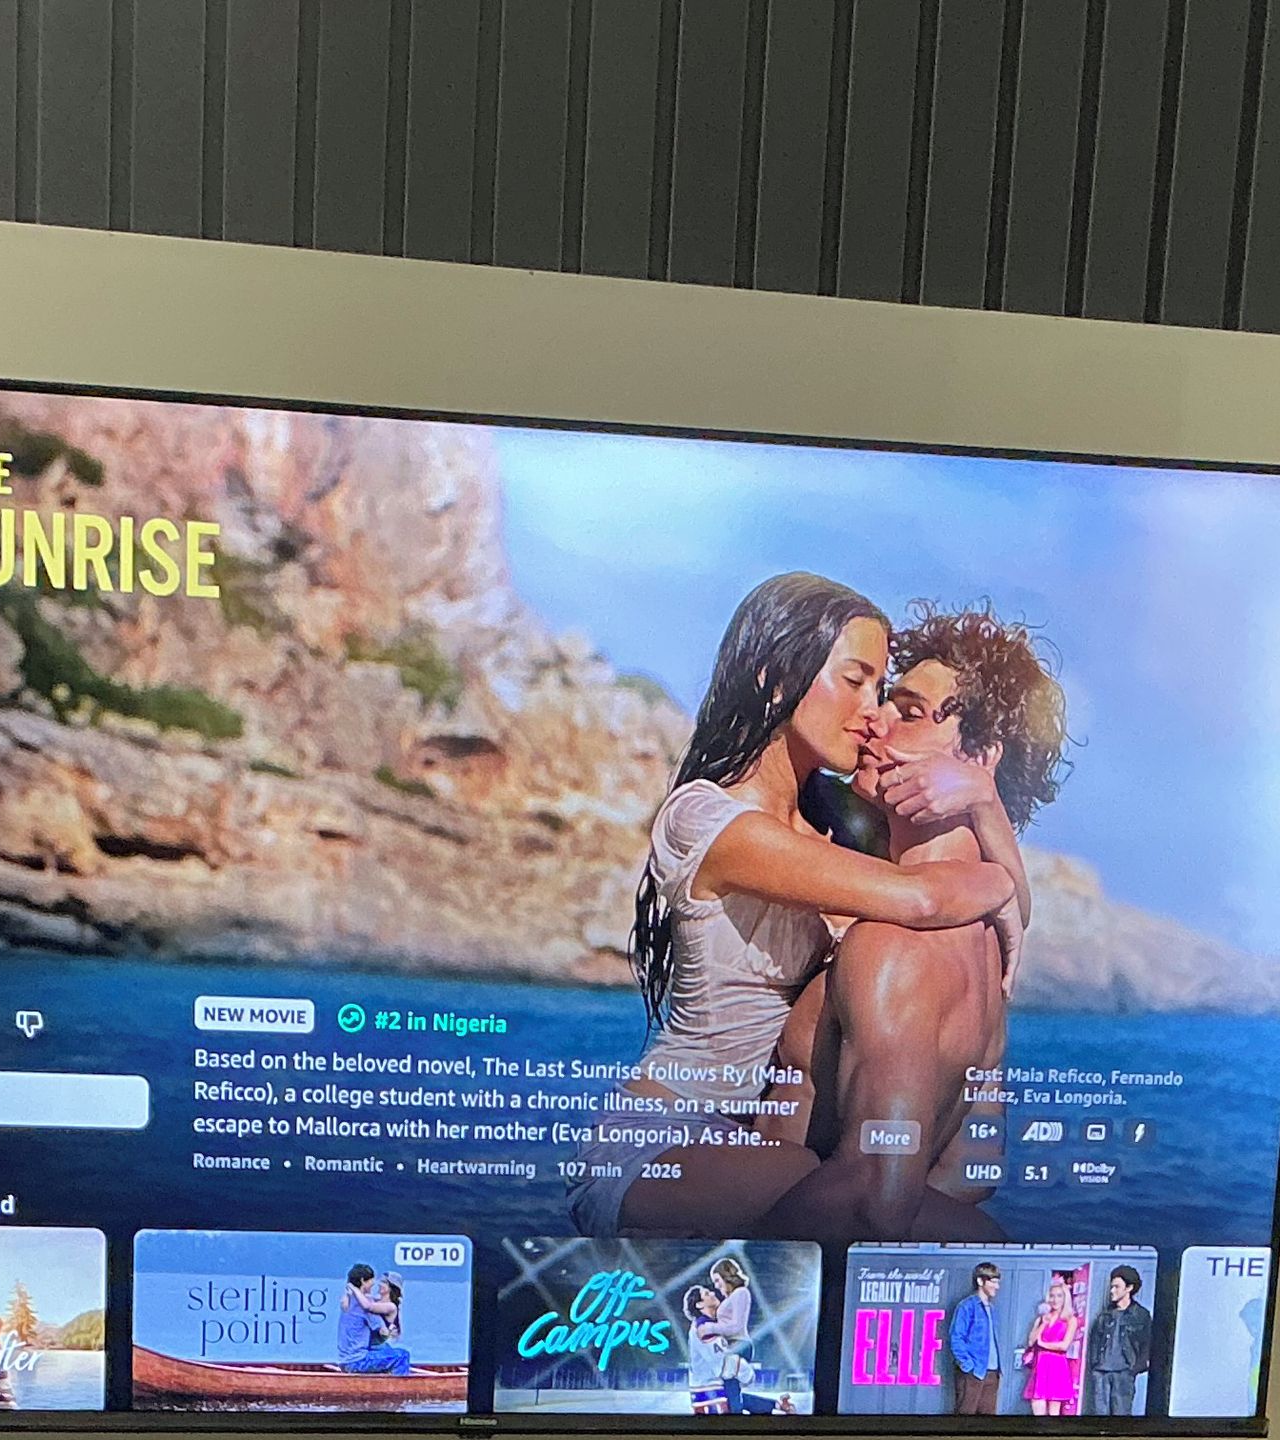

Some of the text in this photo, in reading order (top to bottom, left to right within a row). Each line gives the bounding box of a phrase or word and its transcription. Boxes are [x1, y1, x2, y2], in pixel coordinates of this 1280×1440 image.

[204, 1007, 306, 1024] NEW MOVIE
[375, 1011, 507, 1037] #2 in Nigeria
[194, 1049, 803, 1087] Based on the beloved novel, The Last Sunrise follows Ry (Maia
[965, 1067, 1184, 1087] Cast: Maia Reficco, Fernando
[194, 1081, 799, 1116] Reficco), a college student with a chronic illness, on a summer
[964, 1087, 1127, 1107] Lindez, Eva Longoria.
[192, 1118, 262, 1138] escape
[268, 1118, 290, 1134] to
[296, 1116, 381, 1137] Mallorca
[386, 1119, 430, 1139] with
[435, 1120, 469, 1140] her
[474, 1121, 546, 1142] mother
[551, 1122, 592, 1144] (Eva
[598, 1125, 695, 1148] Longoria).
[700, 1126, 723, 1145] As
[870, 1129, 911, 1146] More
[969, 1123, 997, 1139] 16+
[192, 1153, 682, 1179] Romance Romantic Heartwarming 107 min 2026
[965, 1162, 1116, 1181] UHD 5.1 Dolby
[400, 1247, 460, 1261] TOP 10
[858, 1267, 945, 1282] From the world of
[1206, 1257, 1265, 1277] THE
[187, 1275, 328, 1323] sterling
[569, 1269, 655, 1324] Off
[859, 1281, 940, 1303] LEGALLY blonde
[200, 1314, 303, 1357] point
[517, 1312, 671, 1372] Campus
[852, 1309, 945, 1386] ELLE
